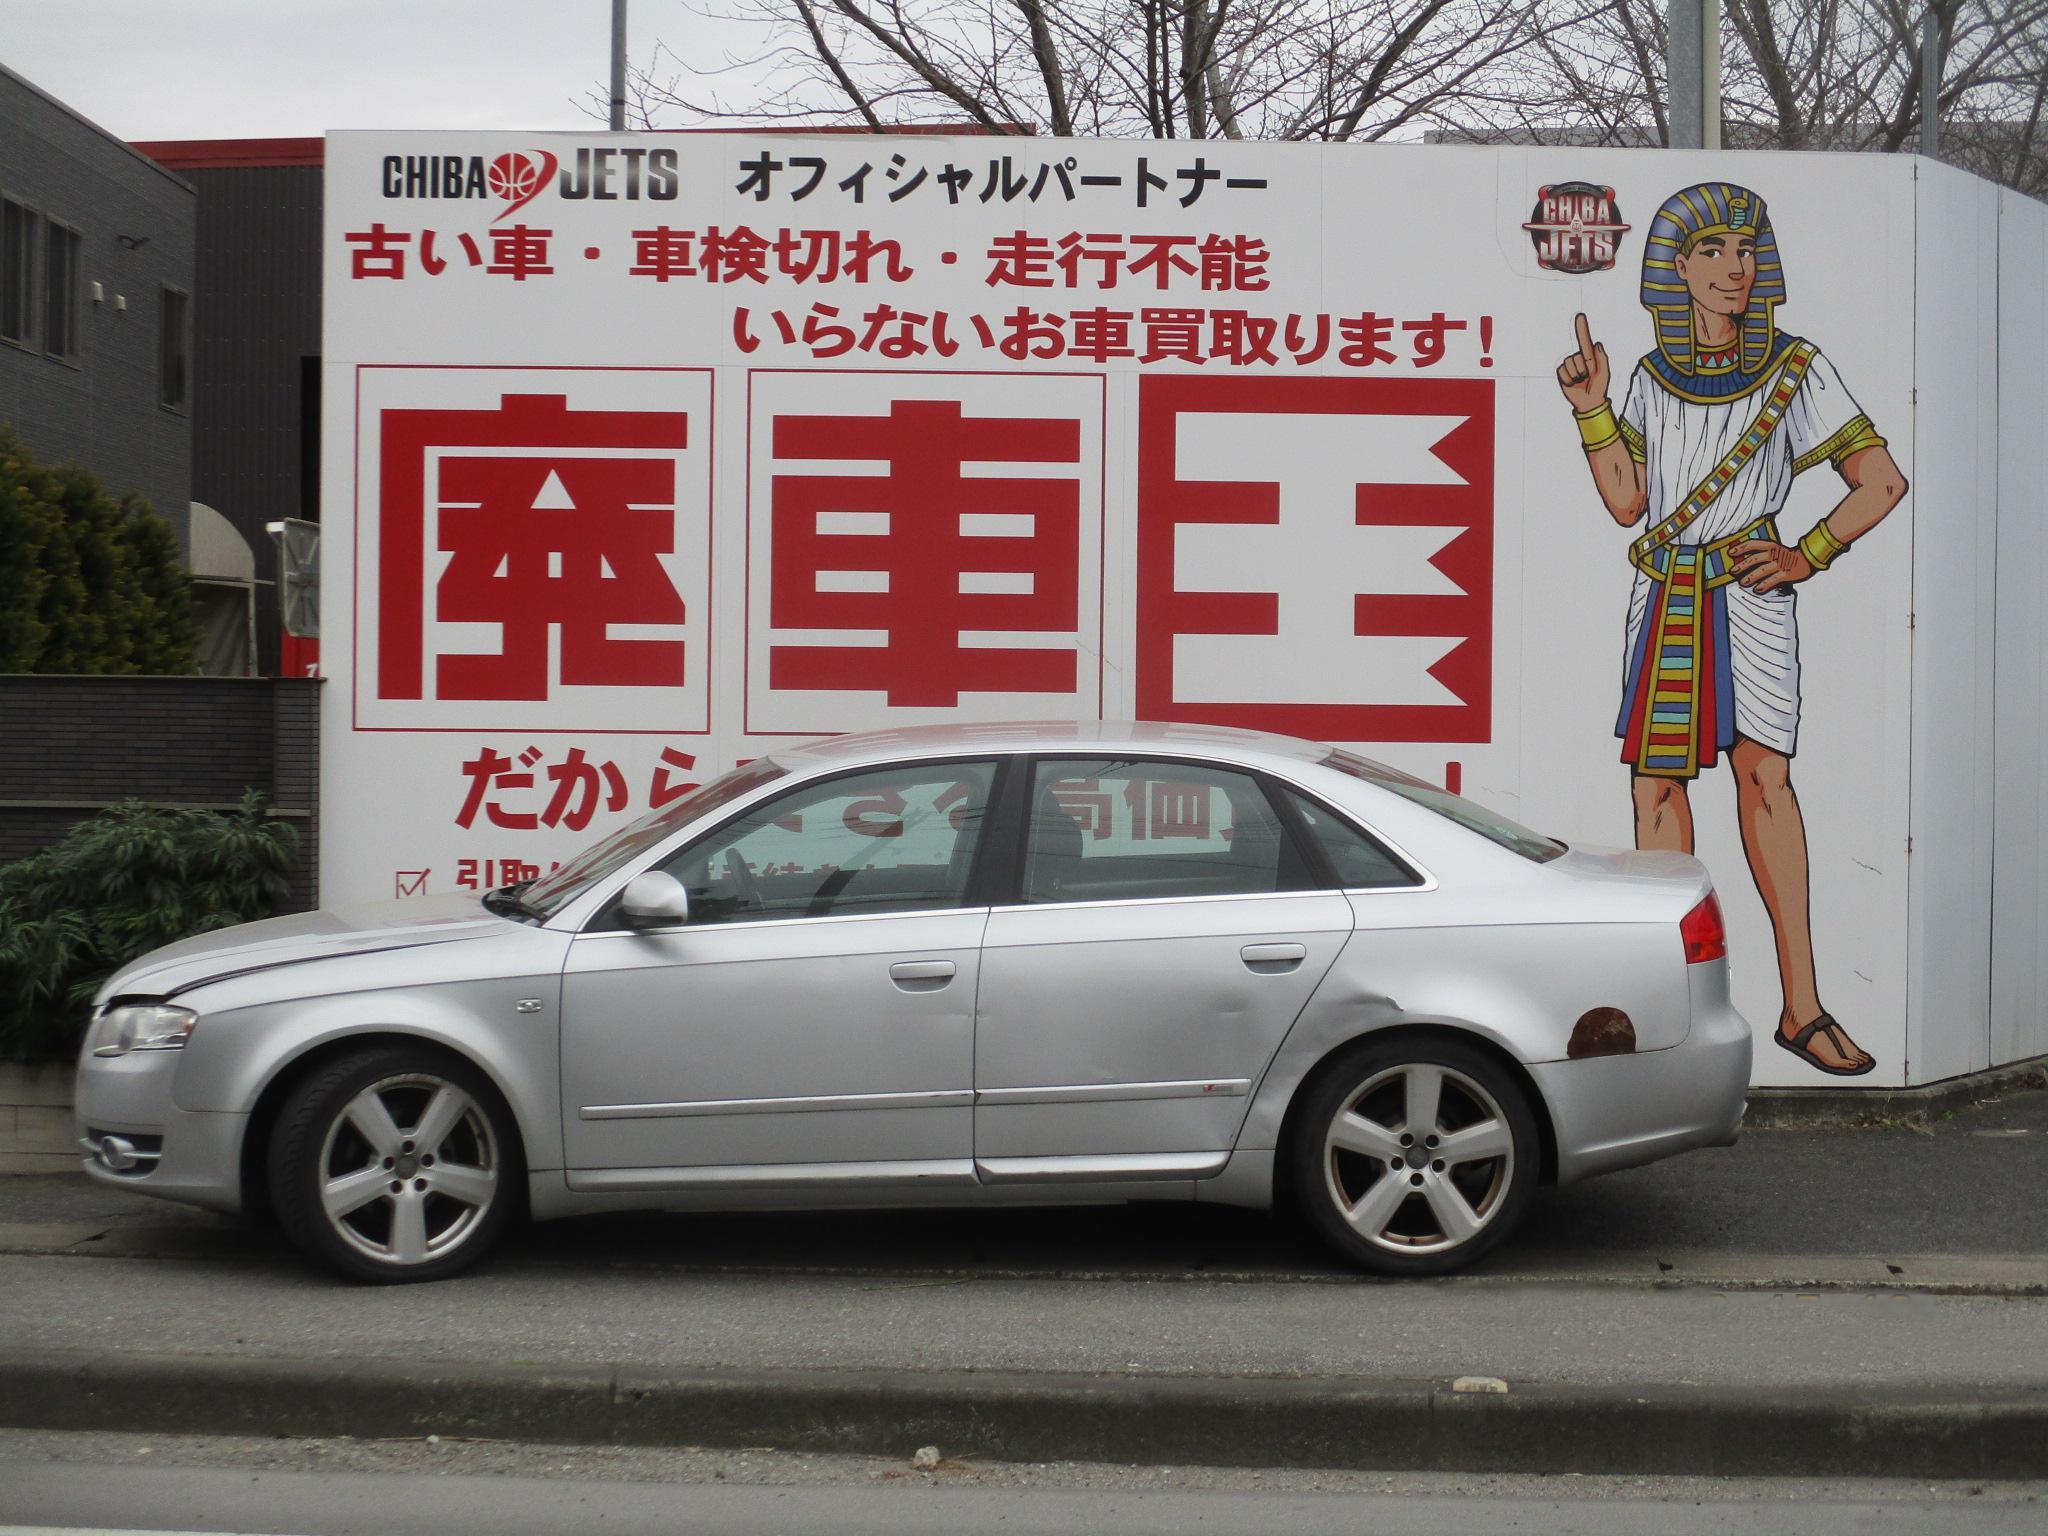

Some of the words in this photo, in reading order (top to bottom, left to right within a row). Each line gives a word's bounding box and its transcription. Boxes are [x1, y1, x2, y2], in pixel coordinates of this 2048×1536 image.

[382, 155, 487, 199] CHIBA
[559, 147, 679, 200] JETS
[735, 150, 1268, 209] オフィシャルパートナー
